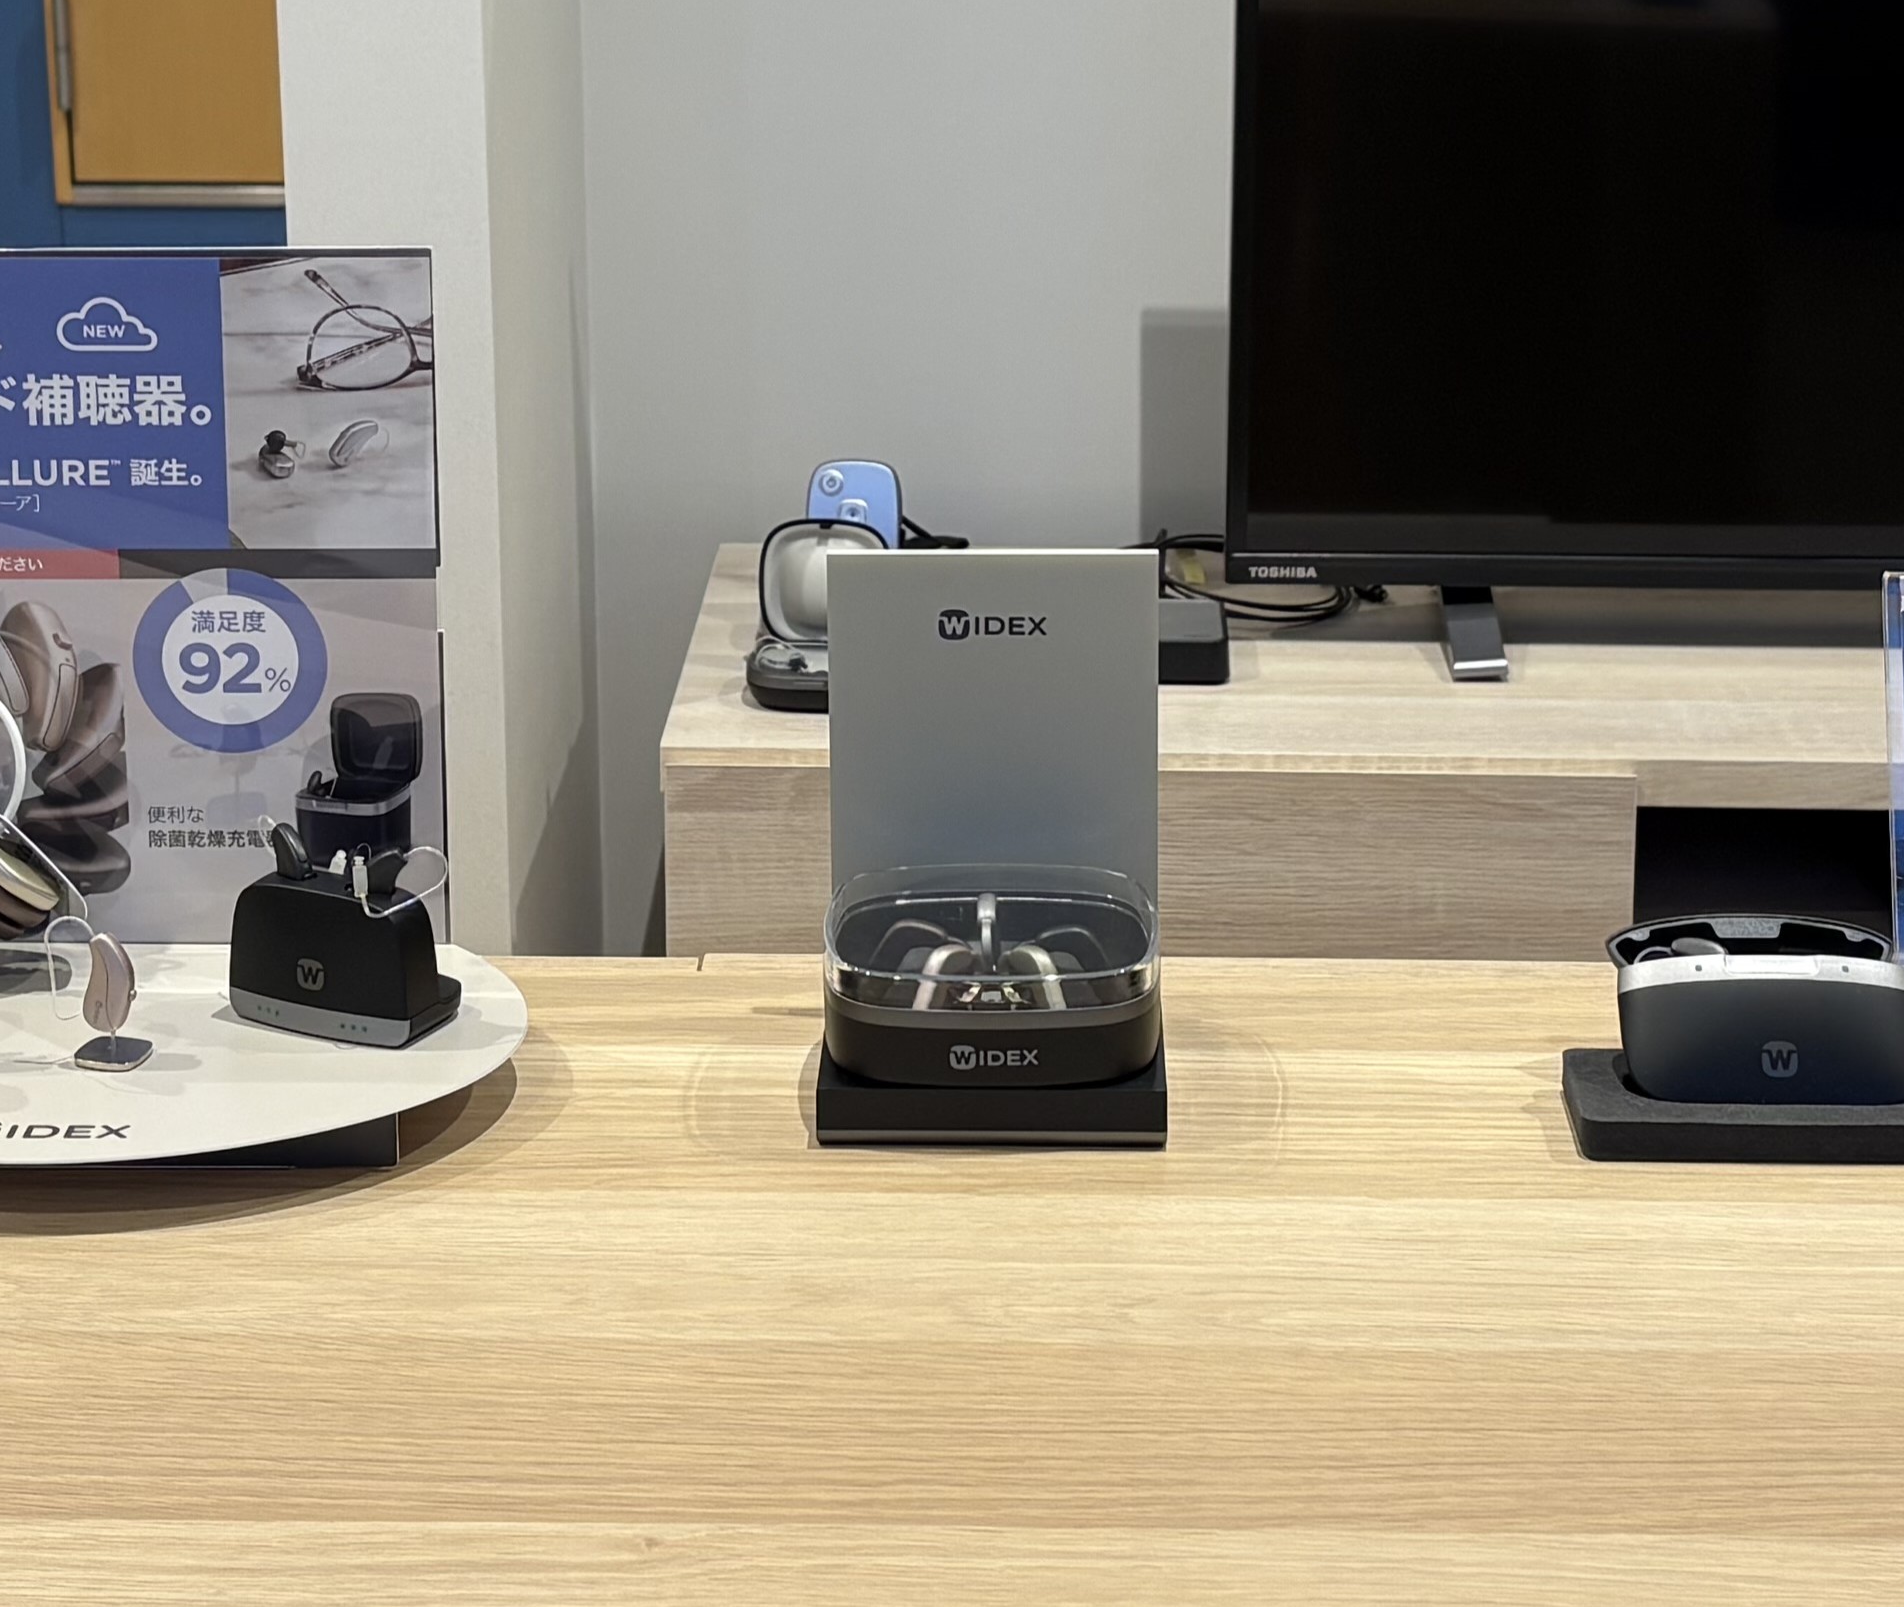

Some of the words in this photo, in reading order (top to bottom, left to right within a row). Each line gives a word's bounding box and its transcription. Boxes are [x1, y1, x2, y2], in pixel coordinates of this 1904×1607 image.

[82, 323, 126, 339] NEW
[129, 458, 204, 487] 誕生。
[1248, 566, 1318, 579] TOSHIBA
[191, 609, 267, 633] 満足度
[937, 609, 1048, 640] WIDEX
[179, 642, 292, 694] 92%
[147, 805, 204, 824] 便利な
[948, 1044, 1039, 1070] WIDEX
